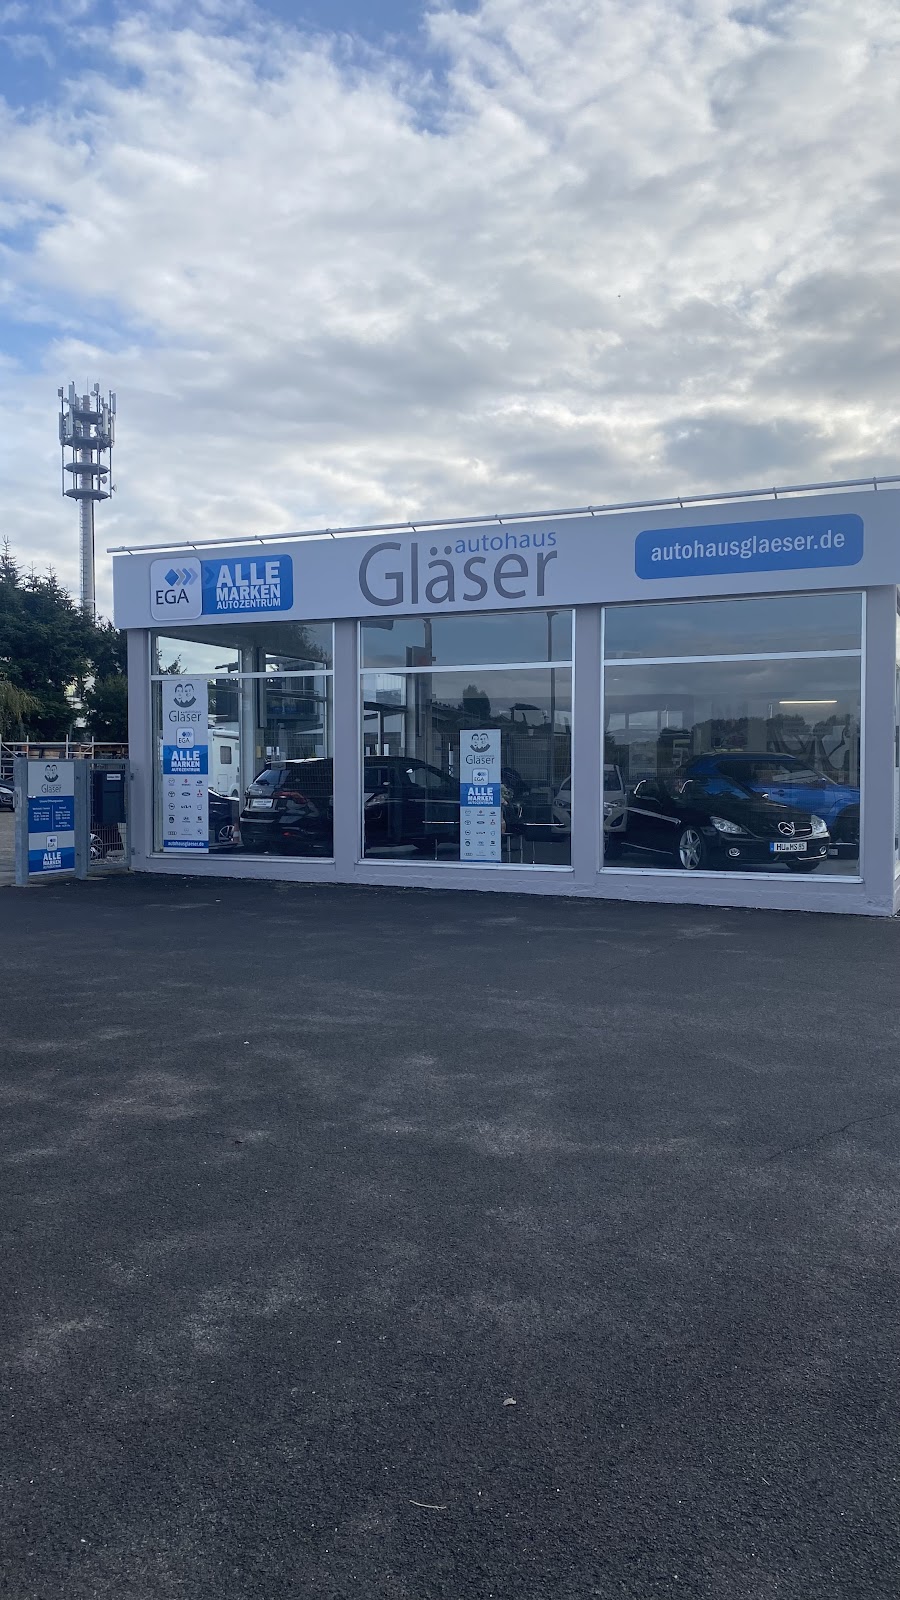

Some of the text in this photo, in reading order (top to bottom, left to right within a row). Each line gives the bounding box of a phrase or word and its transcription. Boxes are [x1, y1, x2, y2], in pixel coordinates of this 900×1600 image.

[455, 531, 557, 554] autohaus
[651, 529, 845, 562] autohausglaeser.de
[216, 561, 280, 587] ALLE
[358, 541, 558, 606] Gläser
[155, 588, 190, 605] EGA
[216, 583, 281, 602] MARKEN
[216, 597, 281, 611] AUTOZENTRUM
[168, 710, 202, 723] Gläser
[171, 750, 200, 761] ALLE
[170, 760, 200, 768] MARKEN
[468, 787, 493, 795] ALLE
[43, 851, 61, 861] ALLE
